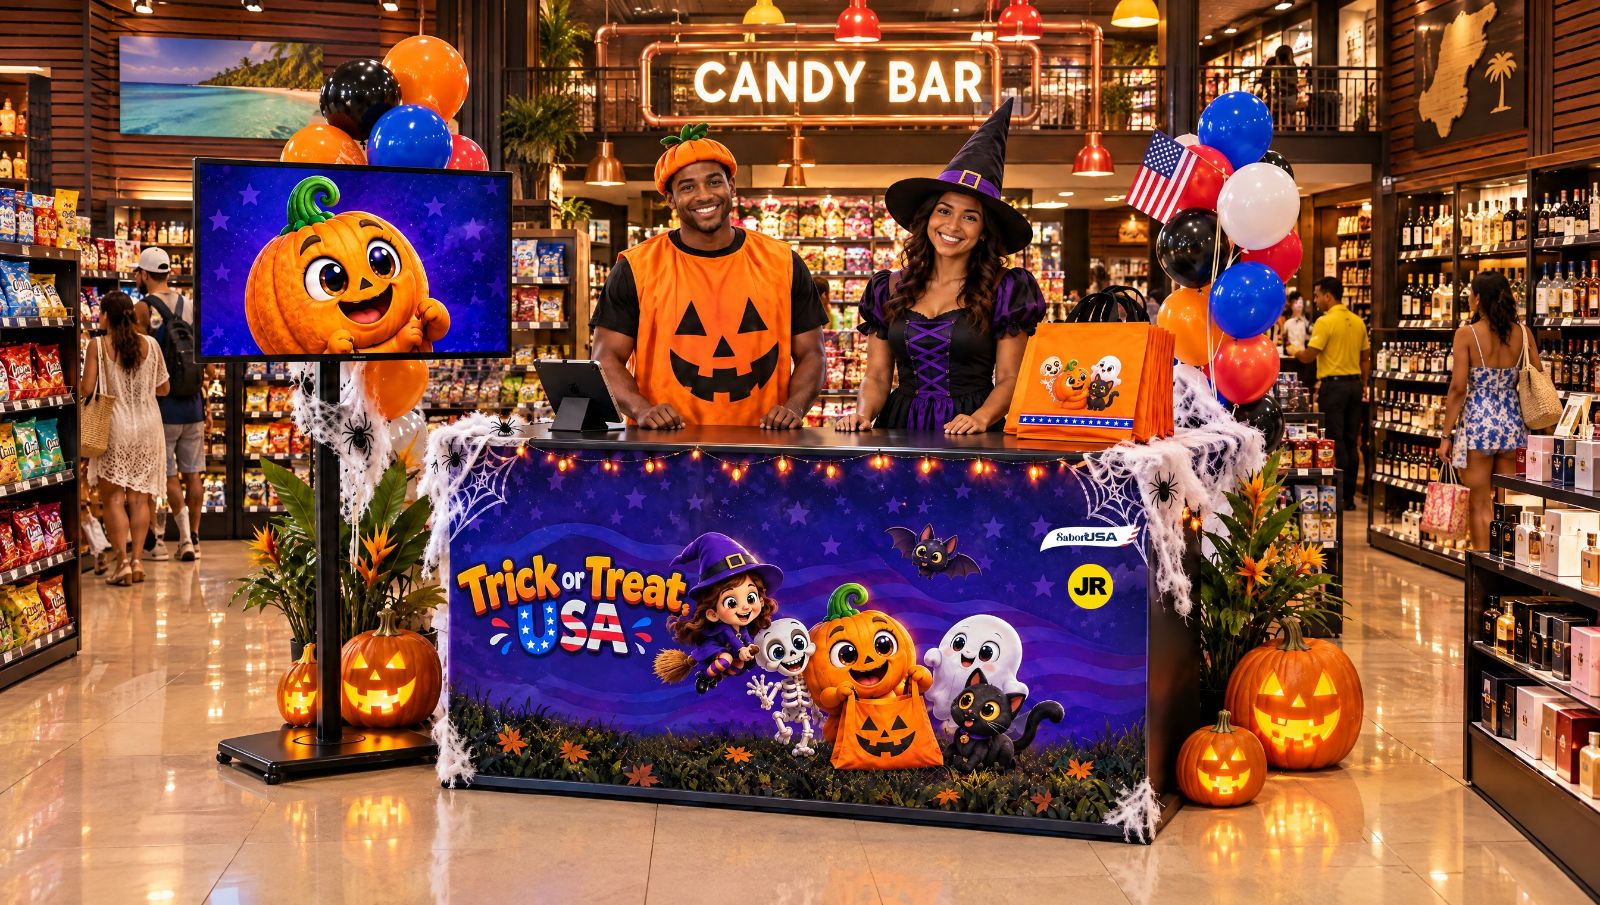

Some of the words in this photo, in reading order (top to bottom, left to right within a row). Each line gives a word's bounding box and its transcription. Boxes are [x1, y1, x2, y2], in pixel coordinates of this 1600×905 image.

[693, 60, 866, 103] CANDY
[888, 60, 982, 103] BAR
[457, 554, 562, 616] Trick
[561, 570, 585, 590] or
[1073, 576, 1107, 596] JR
[517, 599, 629, 655] USA
